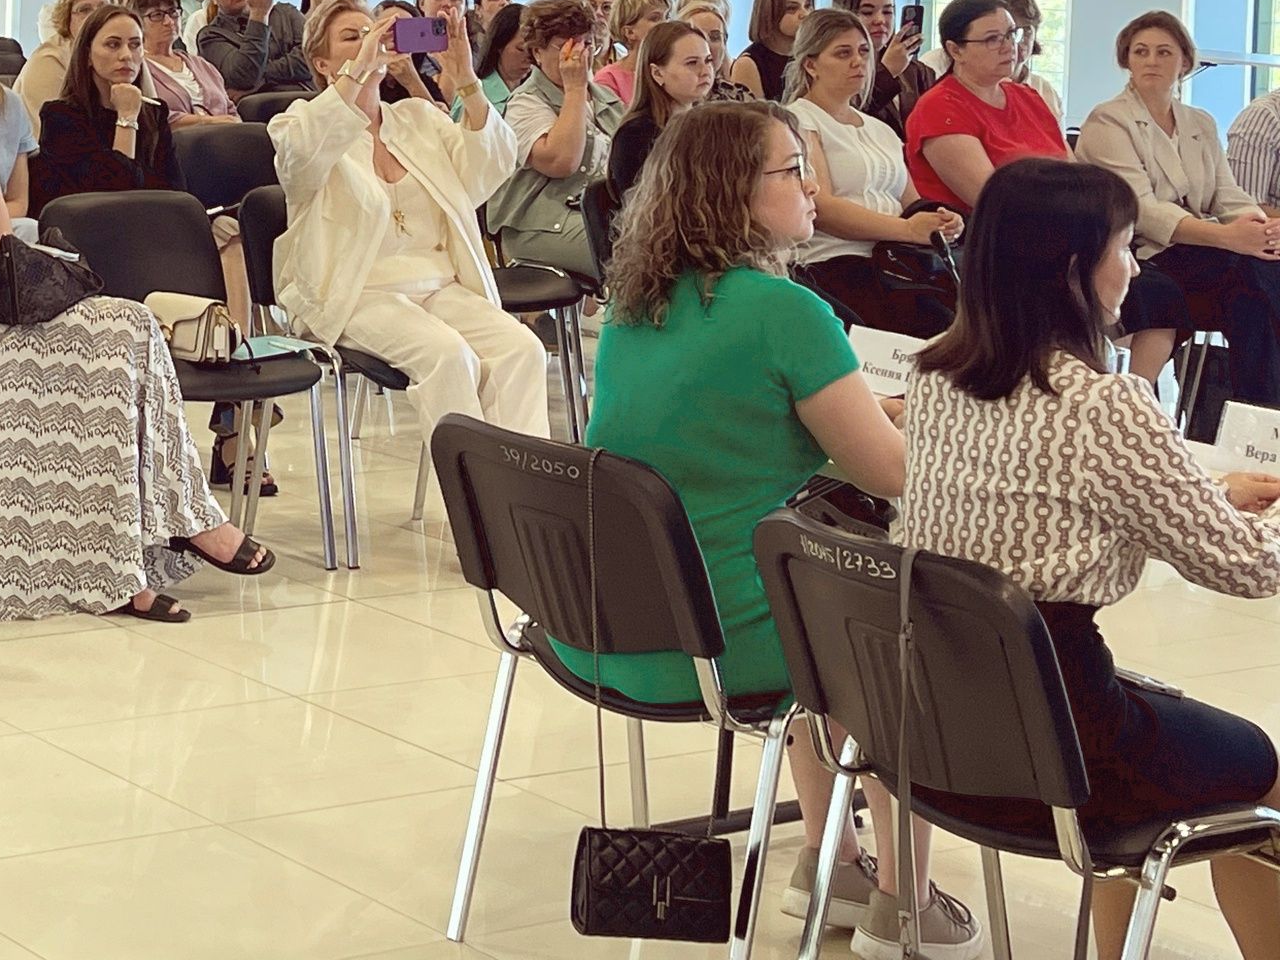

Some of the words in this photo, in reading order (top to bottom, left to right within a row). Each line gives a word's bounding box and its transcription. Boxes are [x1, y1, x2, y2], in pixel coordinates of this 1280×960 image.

[862, 361, 902, 380] Ксения
[500, 445, 580, 478] 39/2050
[1246, 444, 1277, 464] Вера
